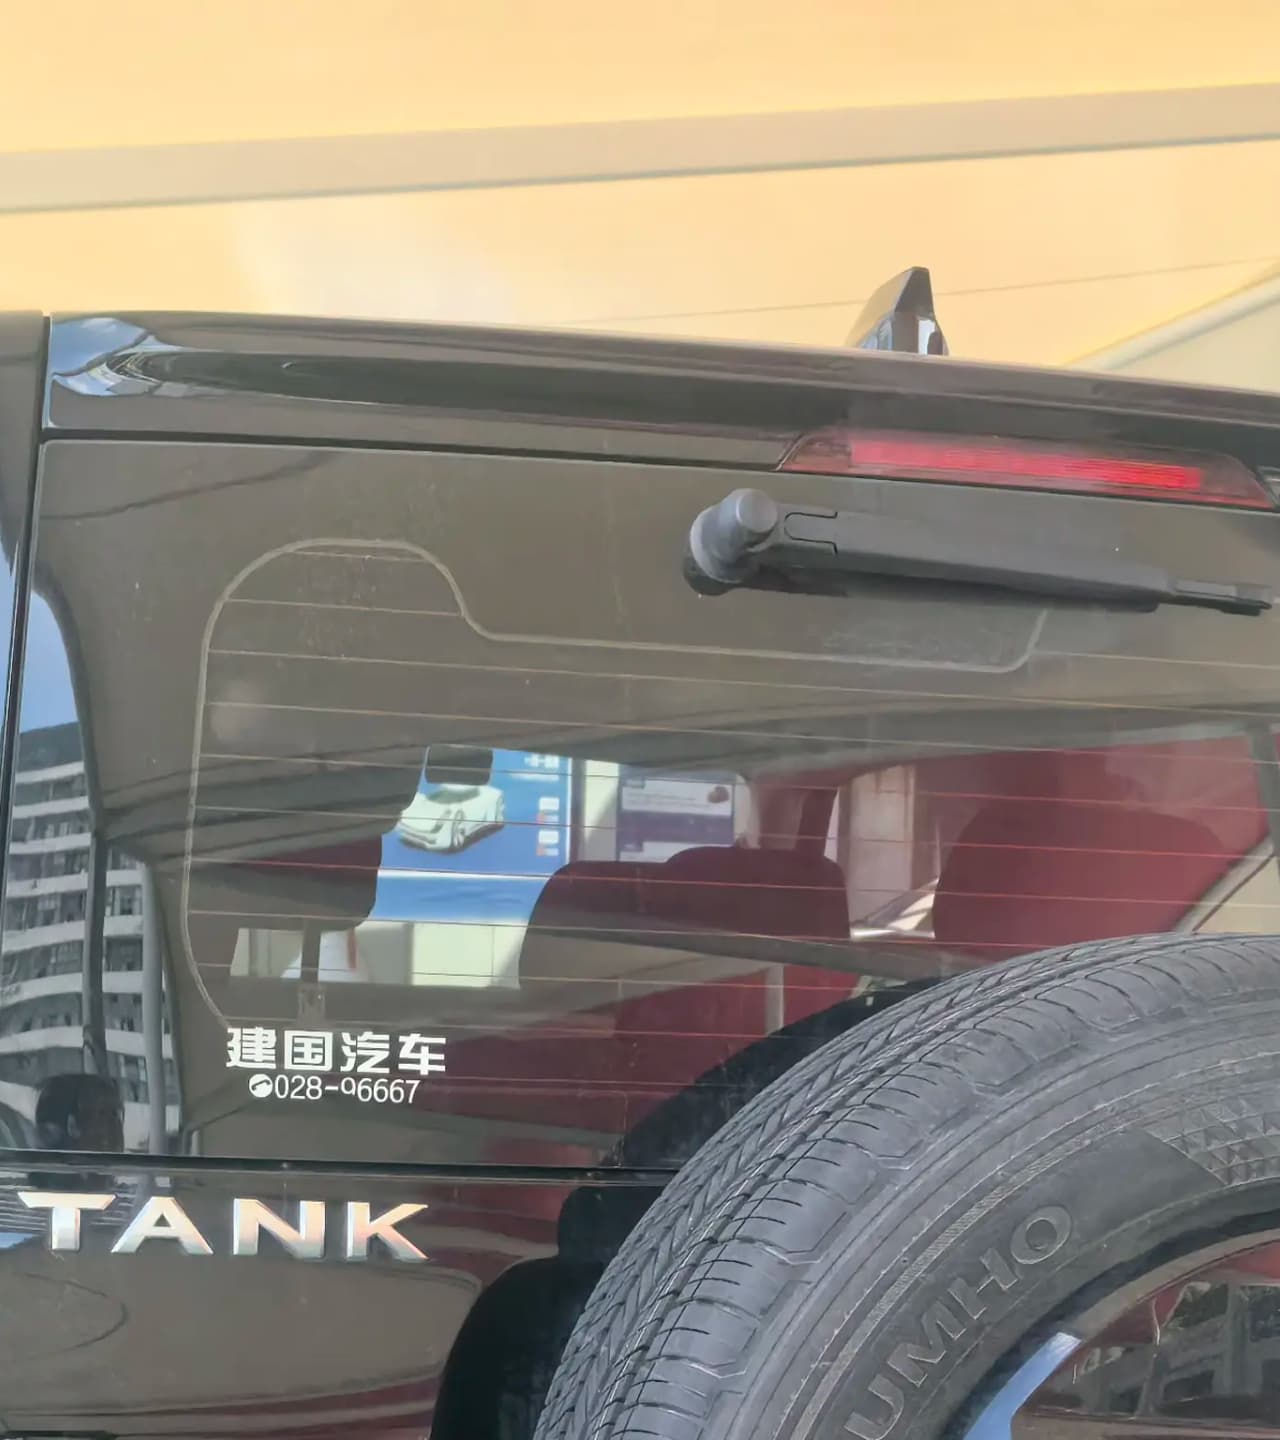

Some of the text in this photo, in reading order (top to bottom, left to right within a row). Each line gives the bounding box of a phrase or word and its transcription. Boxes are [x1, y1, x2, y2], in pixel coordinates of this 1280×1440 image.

[226, 1027, 447, 1076] 建国汽车
[274, 1074, 421, 1104] 028-96667
[18, 1192, 429, 1261] TANK
